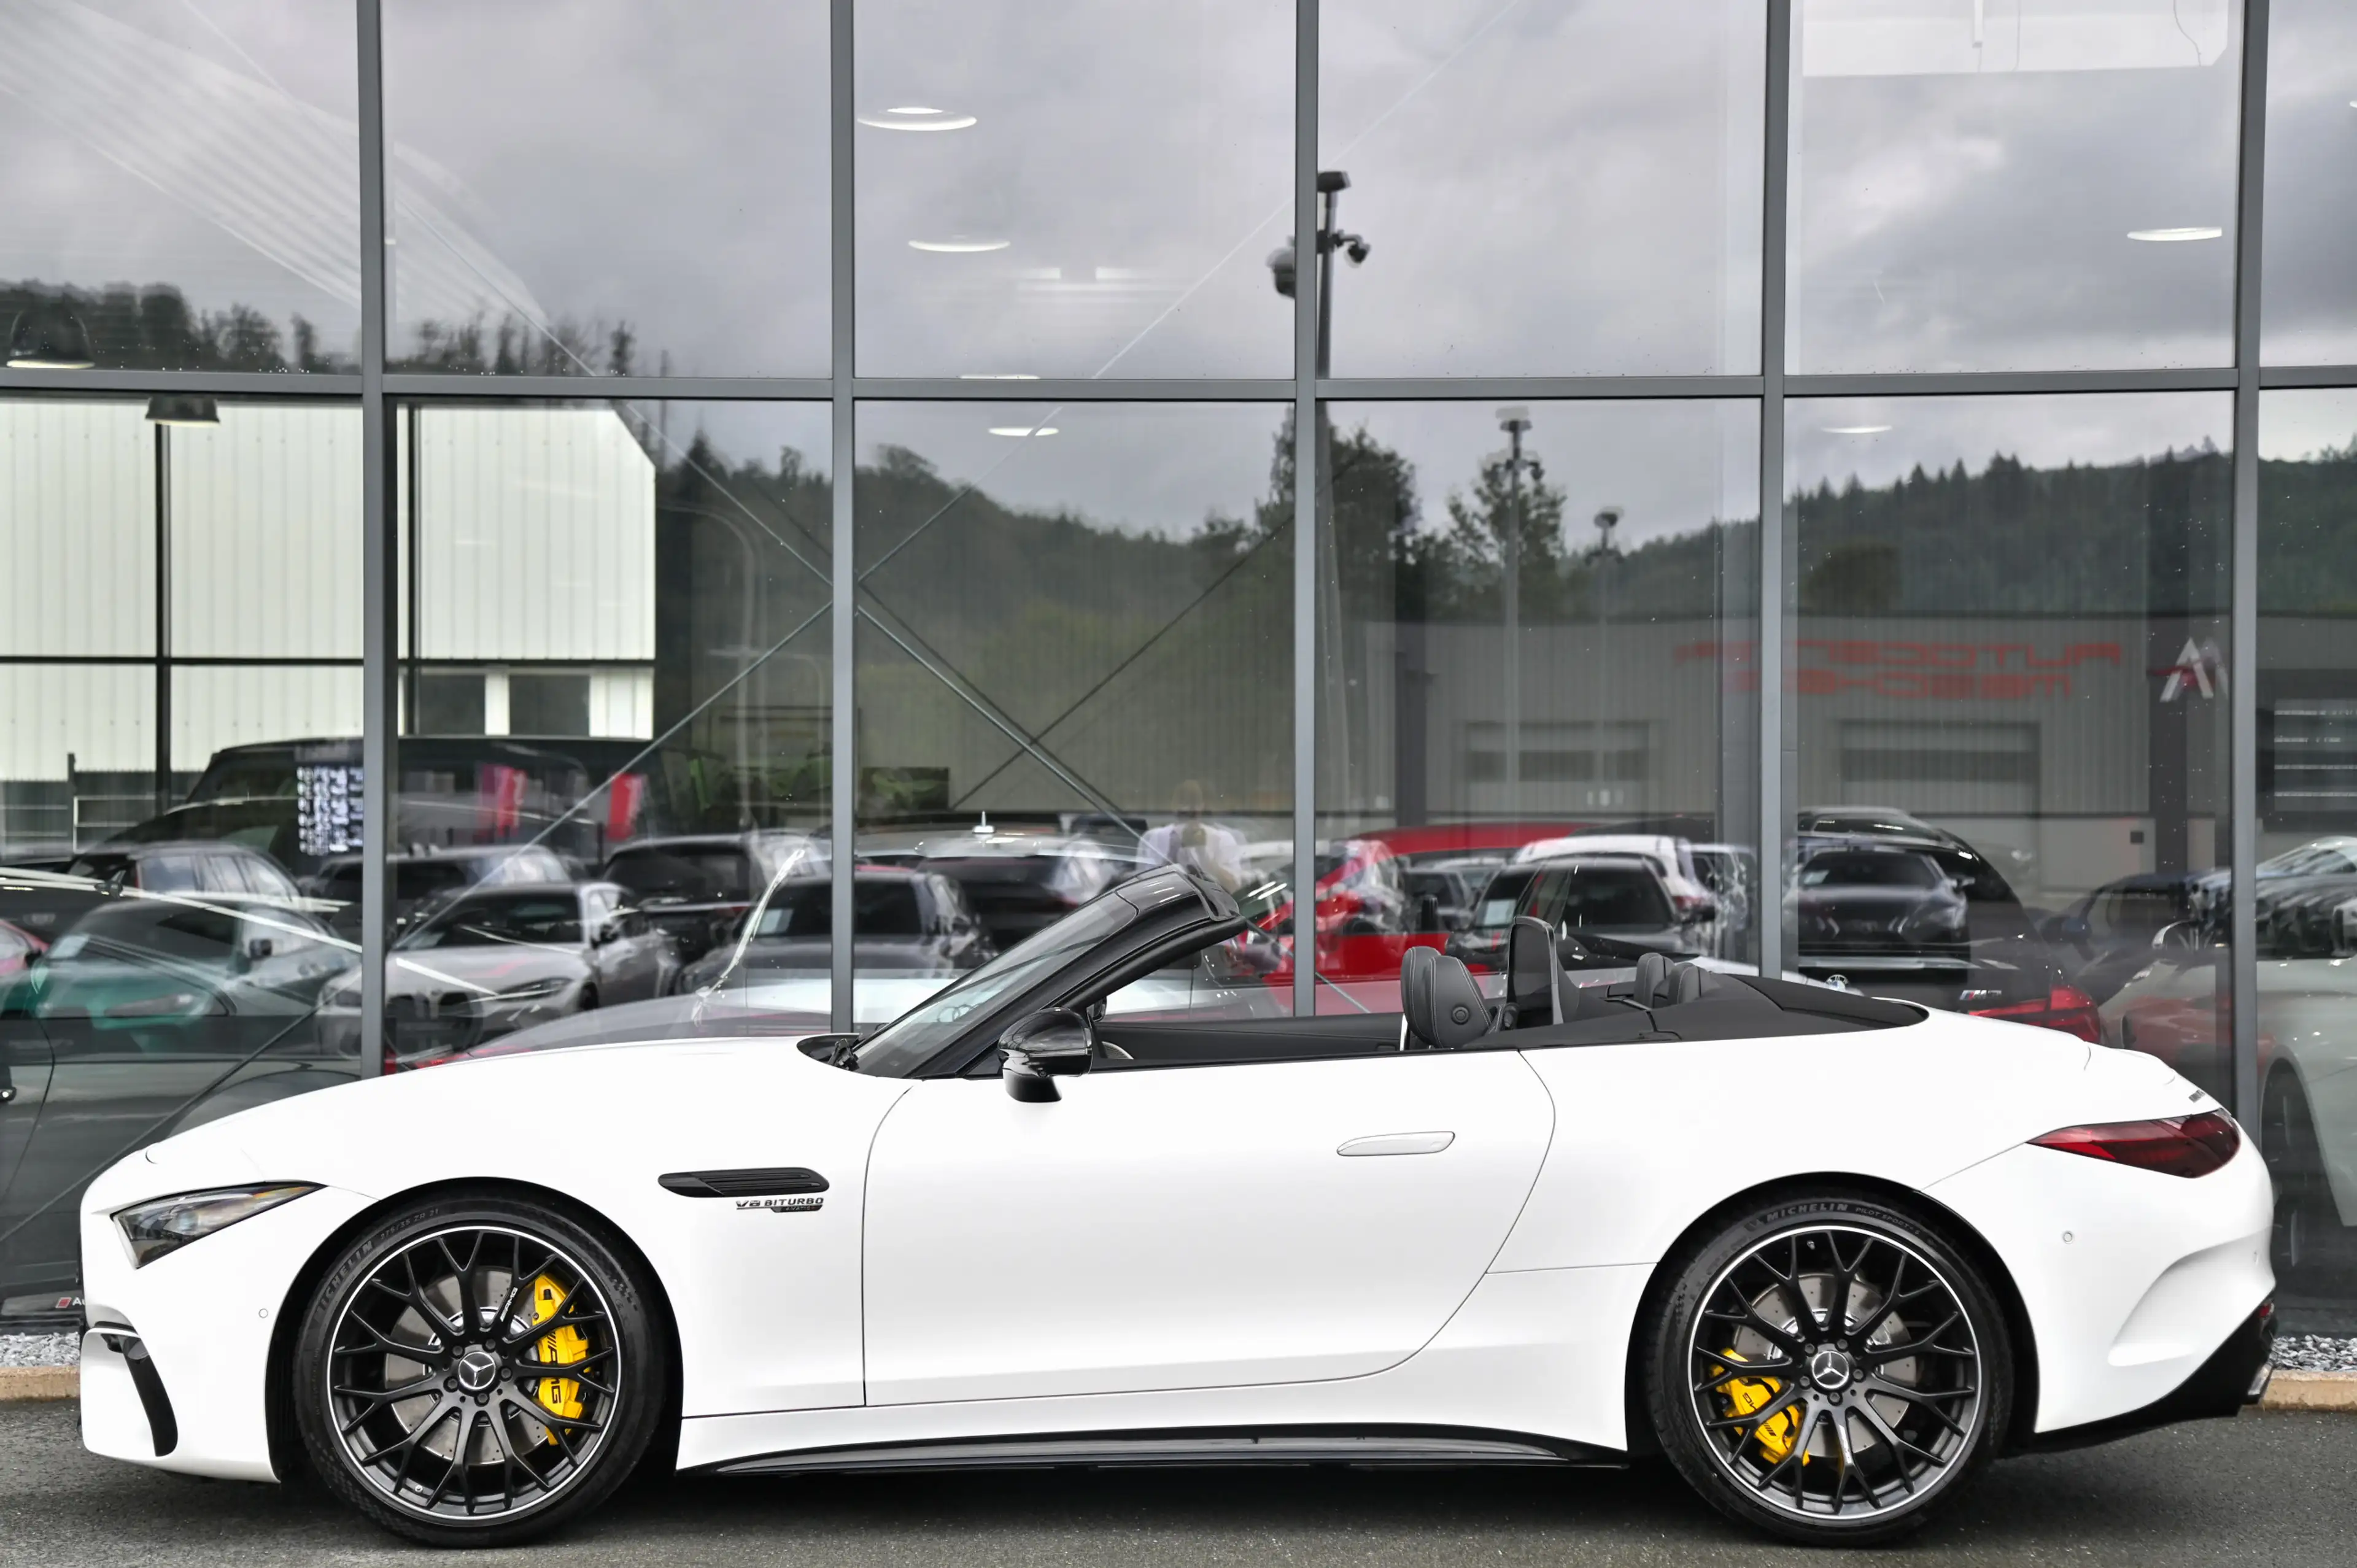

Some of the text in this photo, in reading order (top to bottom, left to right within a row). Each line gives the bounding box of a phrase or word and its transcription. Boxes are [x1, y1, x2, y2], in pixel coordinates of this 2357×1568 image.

[764, 1197, 824, 1207] BITURBO
[1767, 1203, 1849, 1222] MICHELIN
[1856, 1207, 1881, 1217] PILOT
[1881, 1214, 1911, 1228] SPORT
